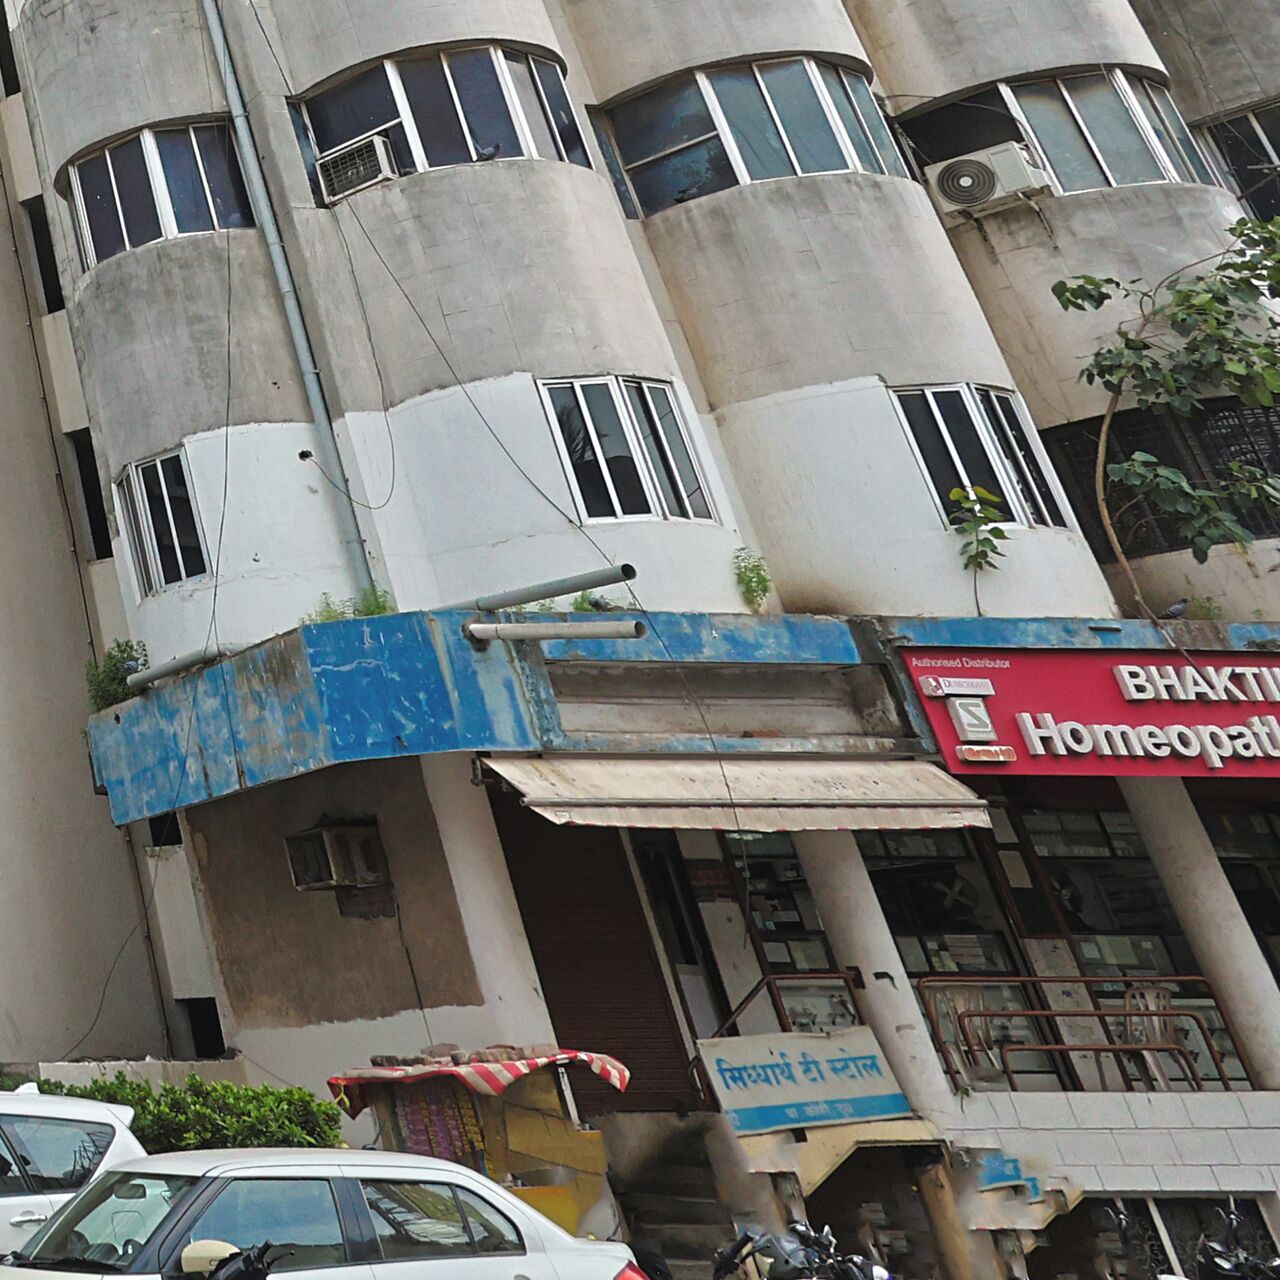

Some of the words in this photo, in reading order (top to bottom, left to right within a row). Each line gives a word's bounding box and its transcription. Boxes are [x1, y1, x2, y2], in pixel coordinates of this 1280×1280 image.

[912, 657, 961, 667] Authorised
[962, 658, 1011, 669] Distributor
[799, 1051, 825, 1082] टी
